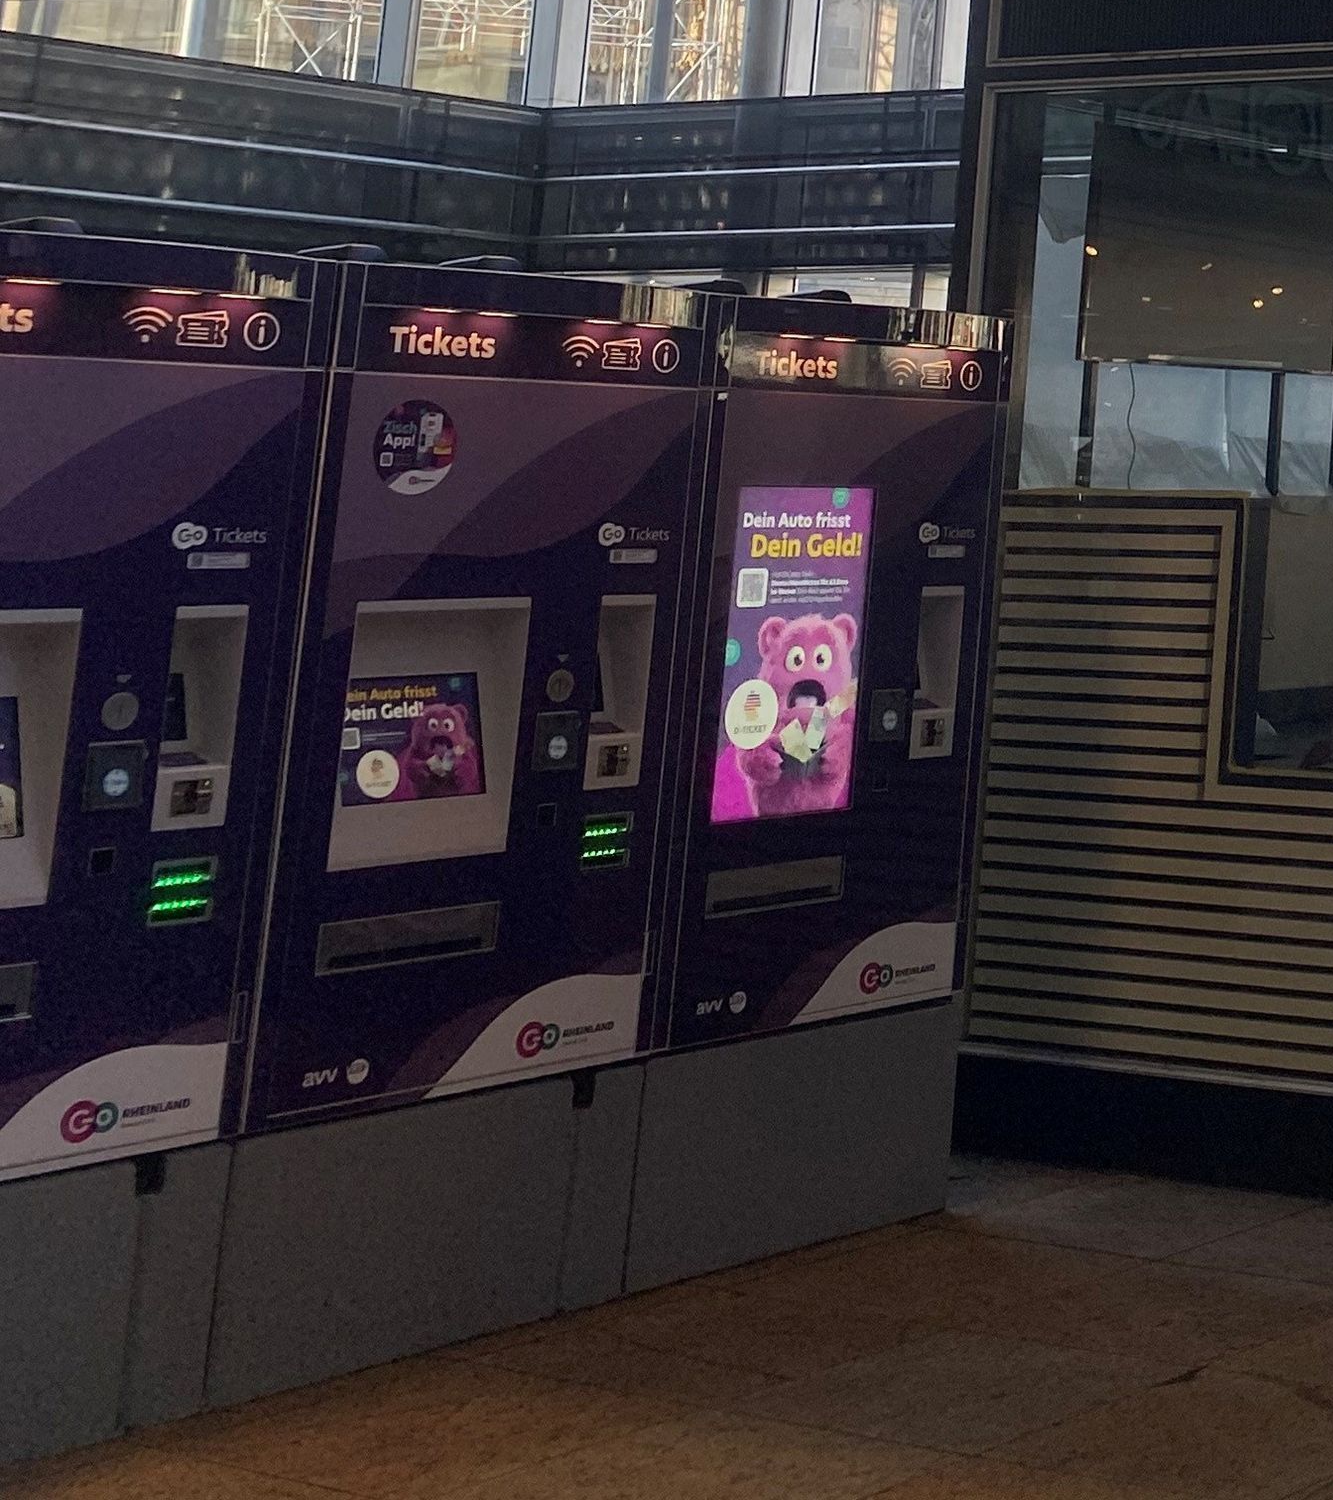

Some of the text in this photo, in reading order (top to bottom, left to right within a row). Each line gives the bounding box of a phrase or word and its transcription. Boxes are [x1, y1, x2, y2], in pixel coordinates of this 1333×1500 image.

[390, 326, 497, 359] Tickets
[756, 350, 838, 380] Tickets
[743, 510, 851, 529] Dein Auto frisst
[213, 527, 267, 543] Tickets
[629, 527, 670, 541] Tickets
[751, 531, 863, 558] Dein Geld!
[346, 685, 437, 702] ein Auto frisst
[380, 701, 424, 720] Geld!
